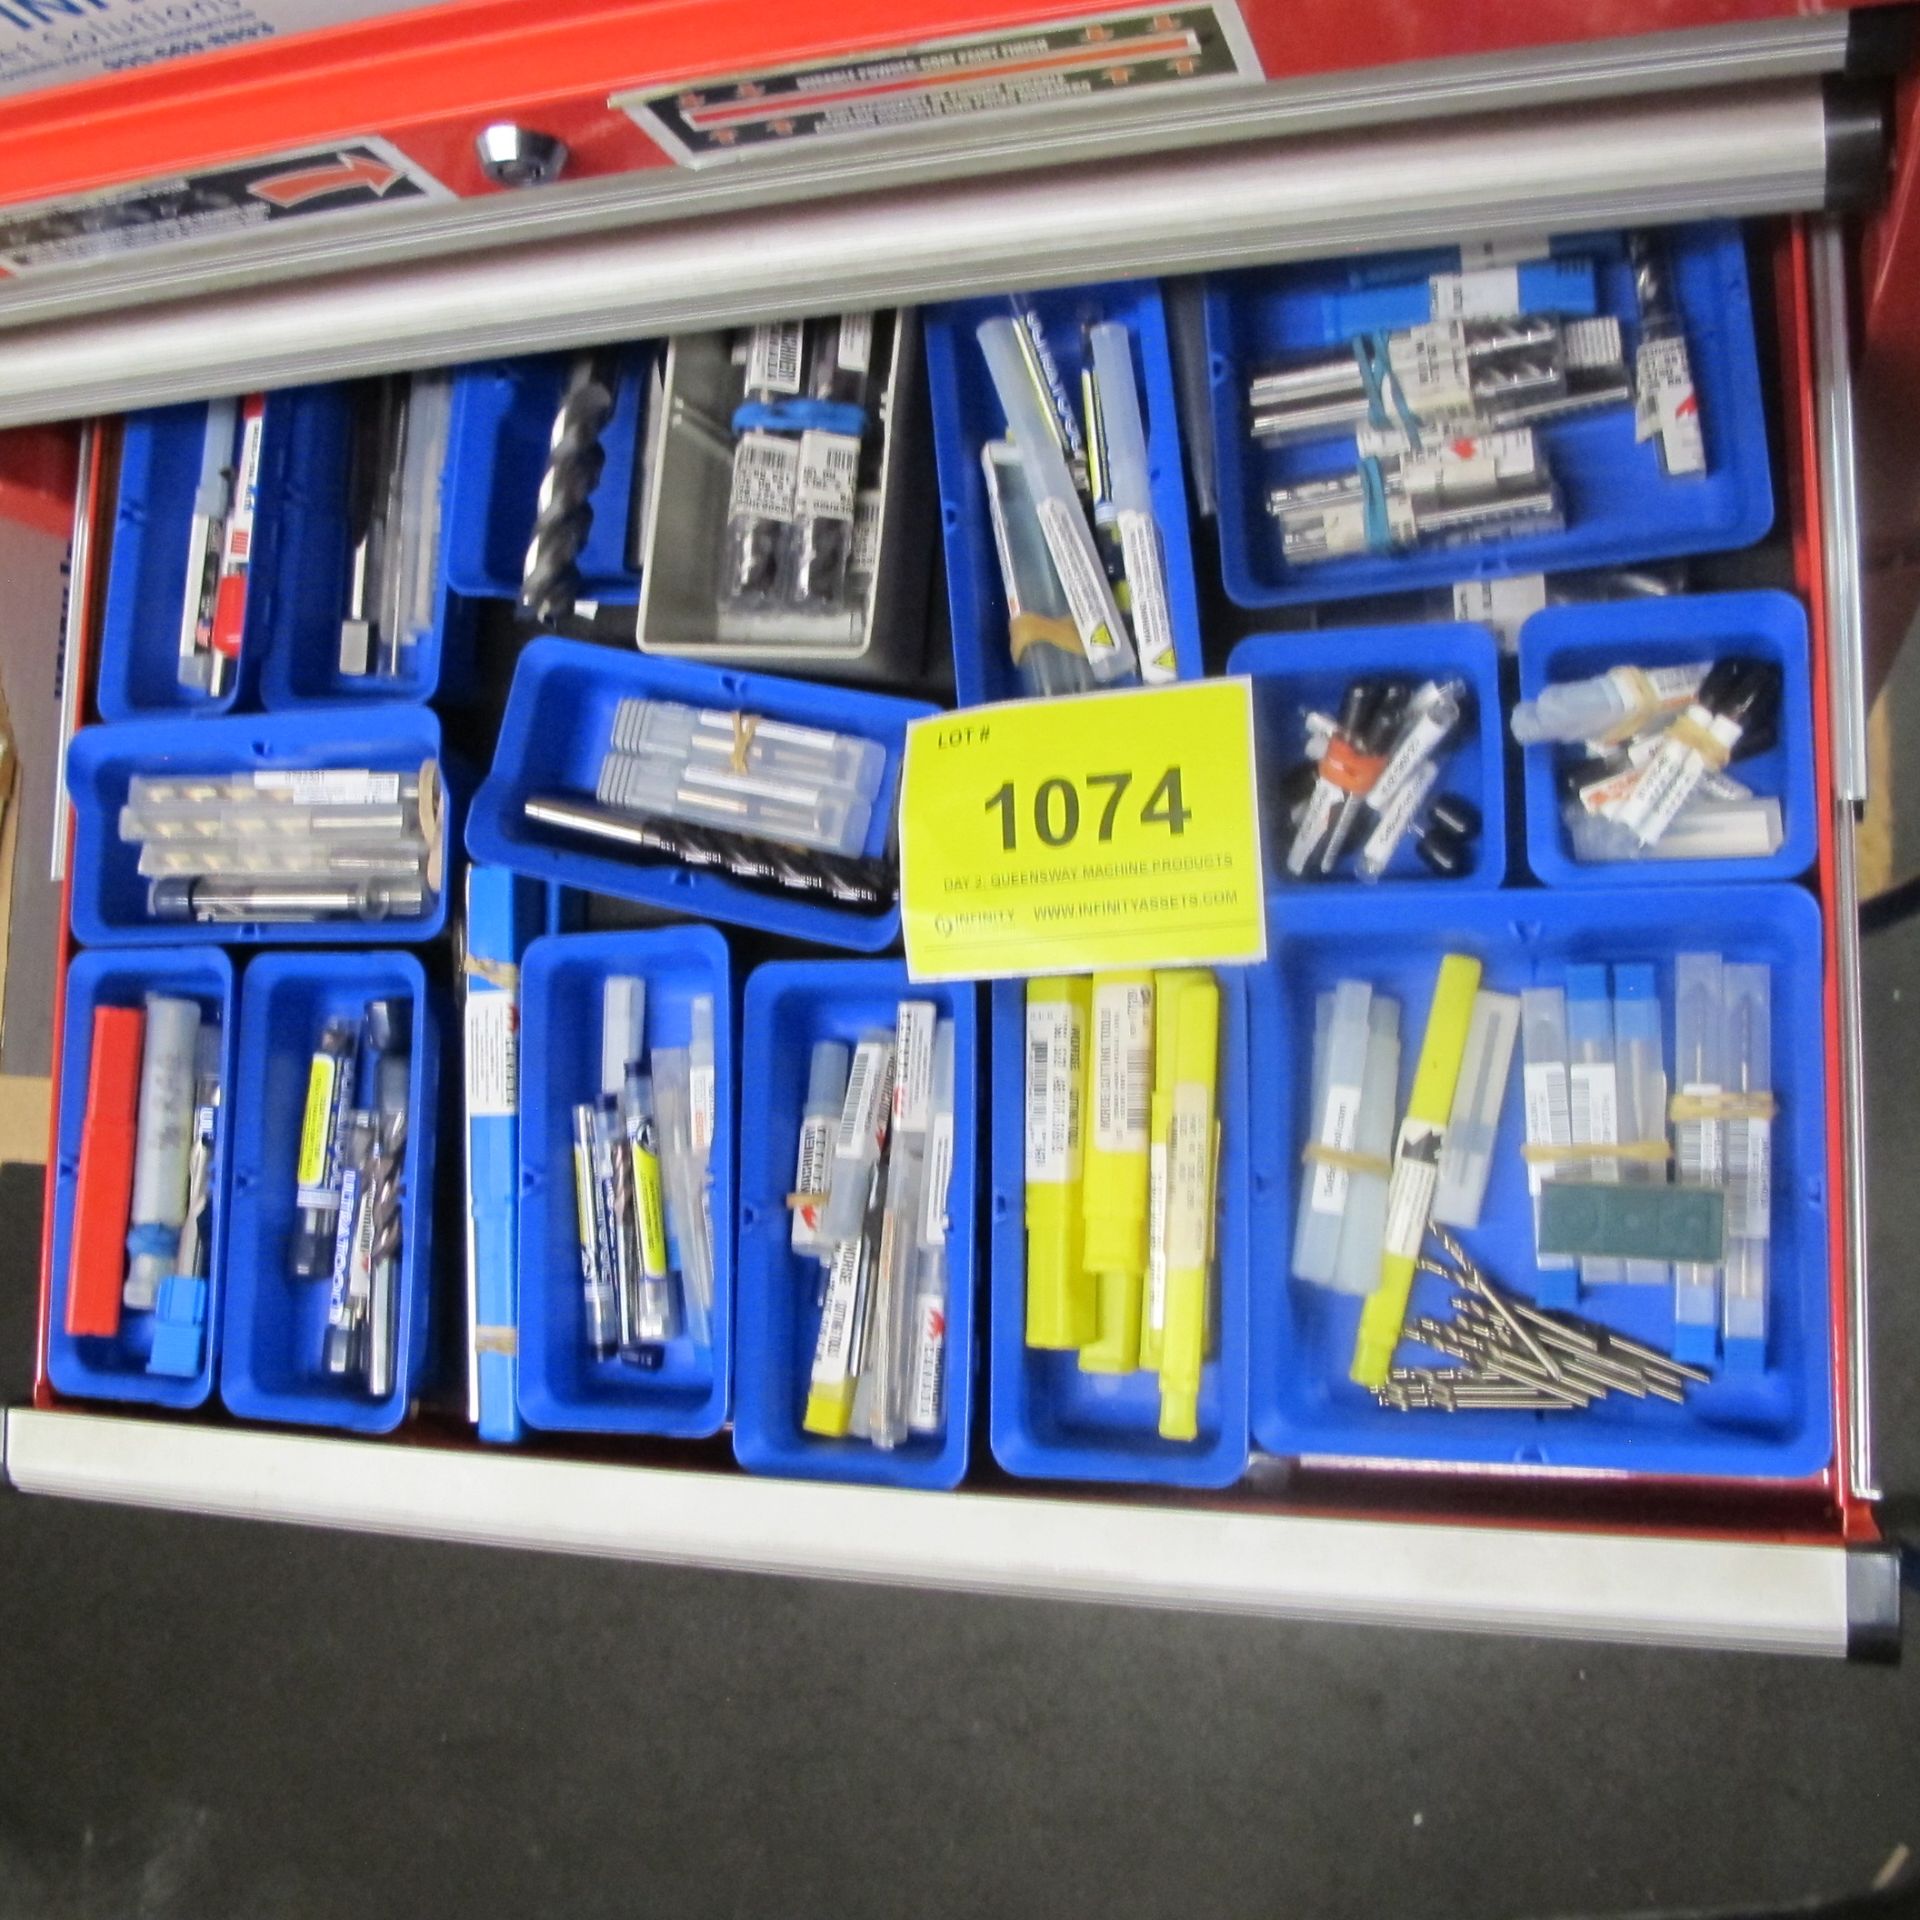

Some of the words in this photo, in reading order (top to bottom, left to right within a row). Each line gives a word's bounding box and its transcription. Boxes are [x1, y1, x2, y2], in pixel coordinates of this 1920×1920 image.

[938, 728, 973, 749] LOT
[979, 725, 991, 743] #
[984, 765, 1192, 853] 1074
[944, 877, 969, 892] DAY
[990, 868, 1079, 887] QUEENSWAY
[1082, 861, 1148, 879] MACHINE
[1152, 855, 1233, 873] PRODUCTS
[954, 908, 1015, 926] INFINITY
[1033, 890, 1238, 921] WWW.INFINITYASSETS.COM
